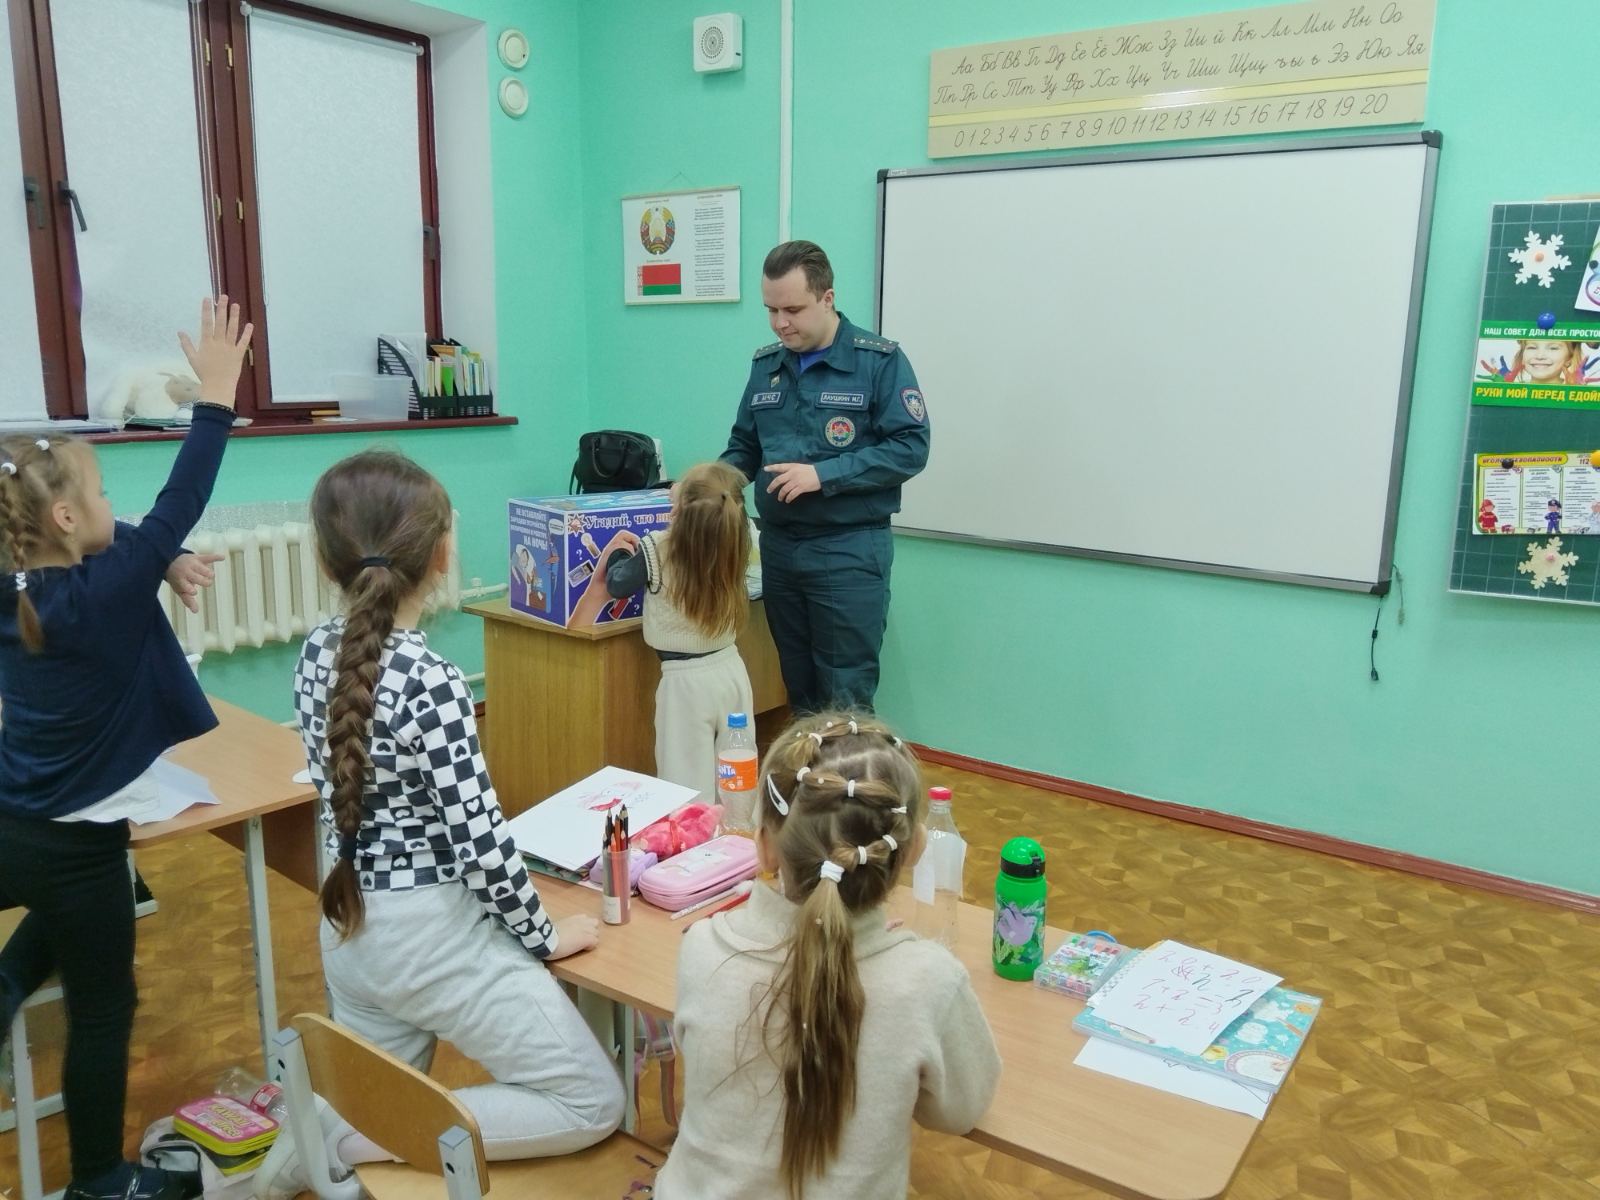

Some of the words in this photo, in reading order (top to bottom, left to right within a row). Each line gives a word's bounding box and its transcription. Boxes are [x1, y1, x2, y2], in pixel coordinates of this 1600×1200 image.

[952, 56, 973, 75] Аа
[980, 52, 1001, 72] Бб
[1002, 51, 1020, 69] Вв
[1025, 47, 1041, 67] Гг
[1044, 45, 1066, 71] Дд
[1071, 42, 1087, 60] Ее
[1091, 37, 1108, 58] Ёё
[1112, 35, 1153, 57] Жж
[1158, 30, 1177, 57] Зз
[1184, 27, 1207, 47] Ии
[1213, 32, 1224, 43] й
[1232, 20, 1257, 42] Кк
[1261, 17, 1291, 38] Лл
[1293, 13, 1335, 35] Мм
[1342, 7, 1372, 29] Нн
[1379, 2, 1403, 24] Оо
[934, 85, 957, 105] Пп
[959, 84, 977, 108] Рр
[983, 81, 997, 99] Сс
[1002, 77, 1036, 98] Тт
[1040, 76, 1057, 100] Уу
[1062, 73, 1084, 98] Фф
[1090, 69, 1119, 89] Хх
[1126, 65, 1150, 88] Цц
[1162, 61, 1180, 81] Чч
[1187, 55, 1221, 77] Шш
[1228, 52, 1267, 78] Щщ
[1311, 55, 1320, 65] ь
[1328, 43, 1349, 63] Ээ
[1356, 38, 1393, 60] Юю
[1397, 33, 1426, 57] Яя
[954, 130, 965, 148] 0
[969, 128, 976, 146] 1
[979, 128, 990, 146] 2
[994, 127, 1005, 144] 3
[1008, 125, 1019, 142] 4
[1024, 124, 1038, 142] 5
[1040, 123, 1051, 141] 6
[1060, 121, 1072, 139] 7
[1076, 120, 1086, 138] 8
[1090, 118, 1102, 136] 9
[1108, 116, 1127, 135] 10
[1131, 115, 1146, 133] 11
[1150, 112, 1168, 132] 12
[1174, 110, 1191, 129] 13
[1197, 108, 1216, 128] 14
[1222, 105, 1246, 126] 15
[1249, 103, 1270, 123] 16
[1277, 101, 1300, 122] 17
[1305, 98, 1327, 119] 18
[1333, 96, 1355, 117] 19
[1360, 93, 1389, 115] 20
[1484, 327, 1501, 335] НАШ
[1504, 328, 1527, 336] СОВЕТ
[1570, 329, 1600, 337] ПРОСТО
[1476, 387, 1503, 398] РУКИ
[1506, 388, 1528, 399] МОЙ
[1531, 390, 1565, 401] ПЕРЕД
[634, 514, 654, 524] что
